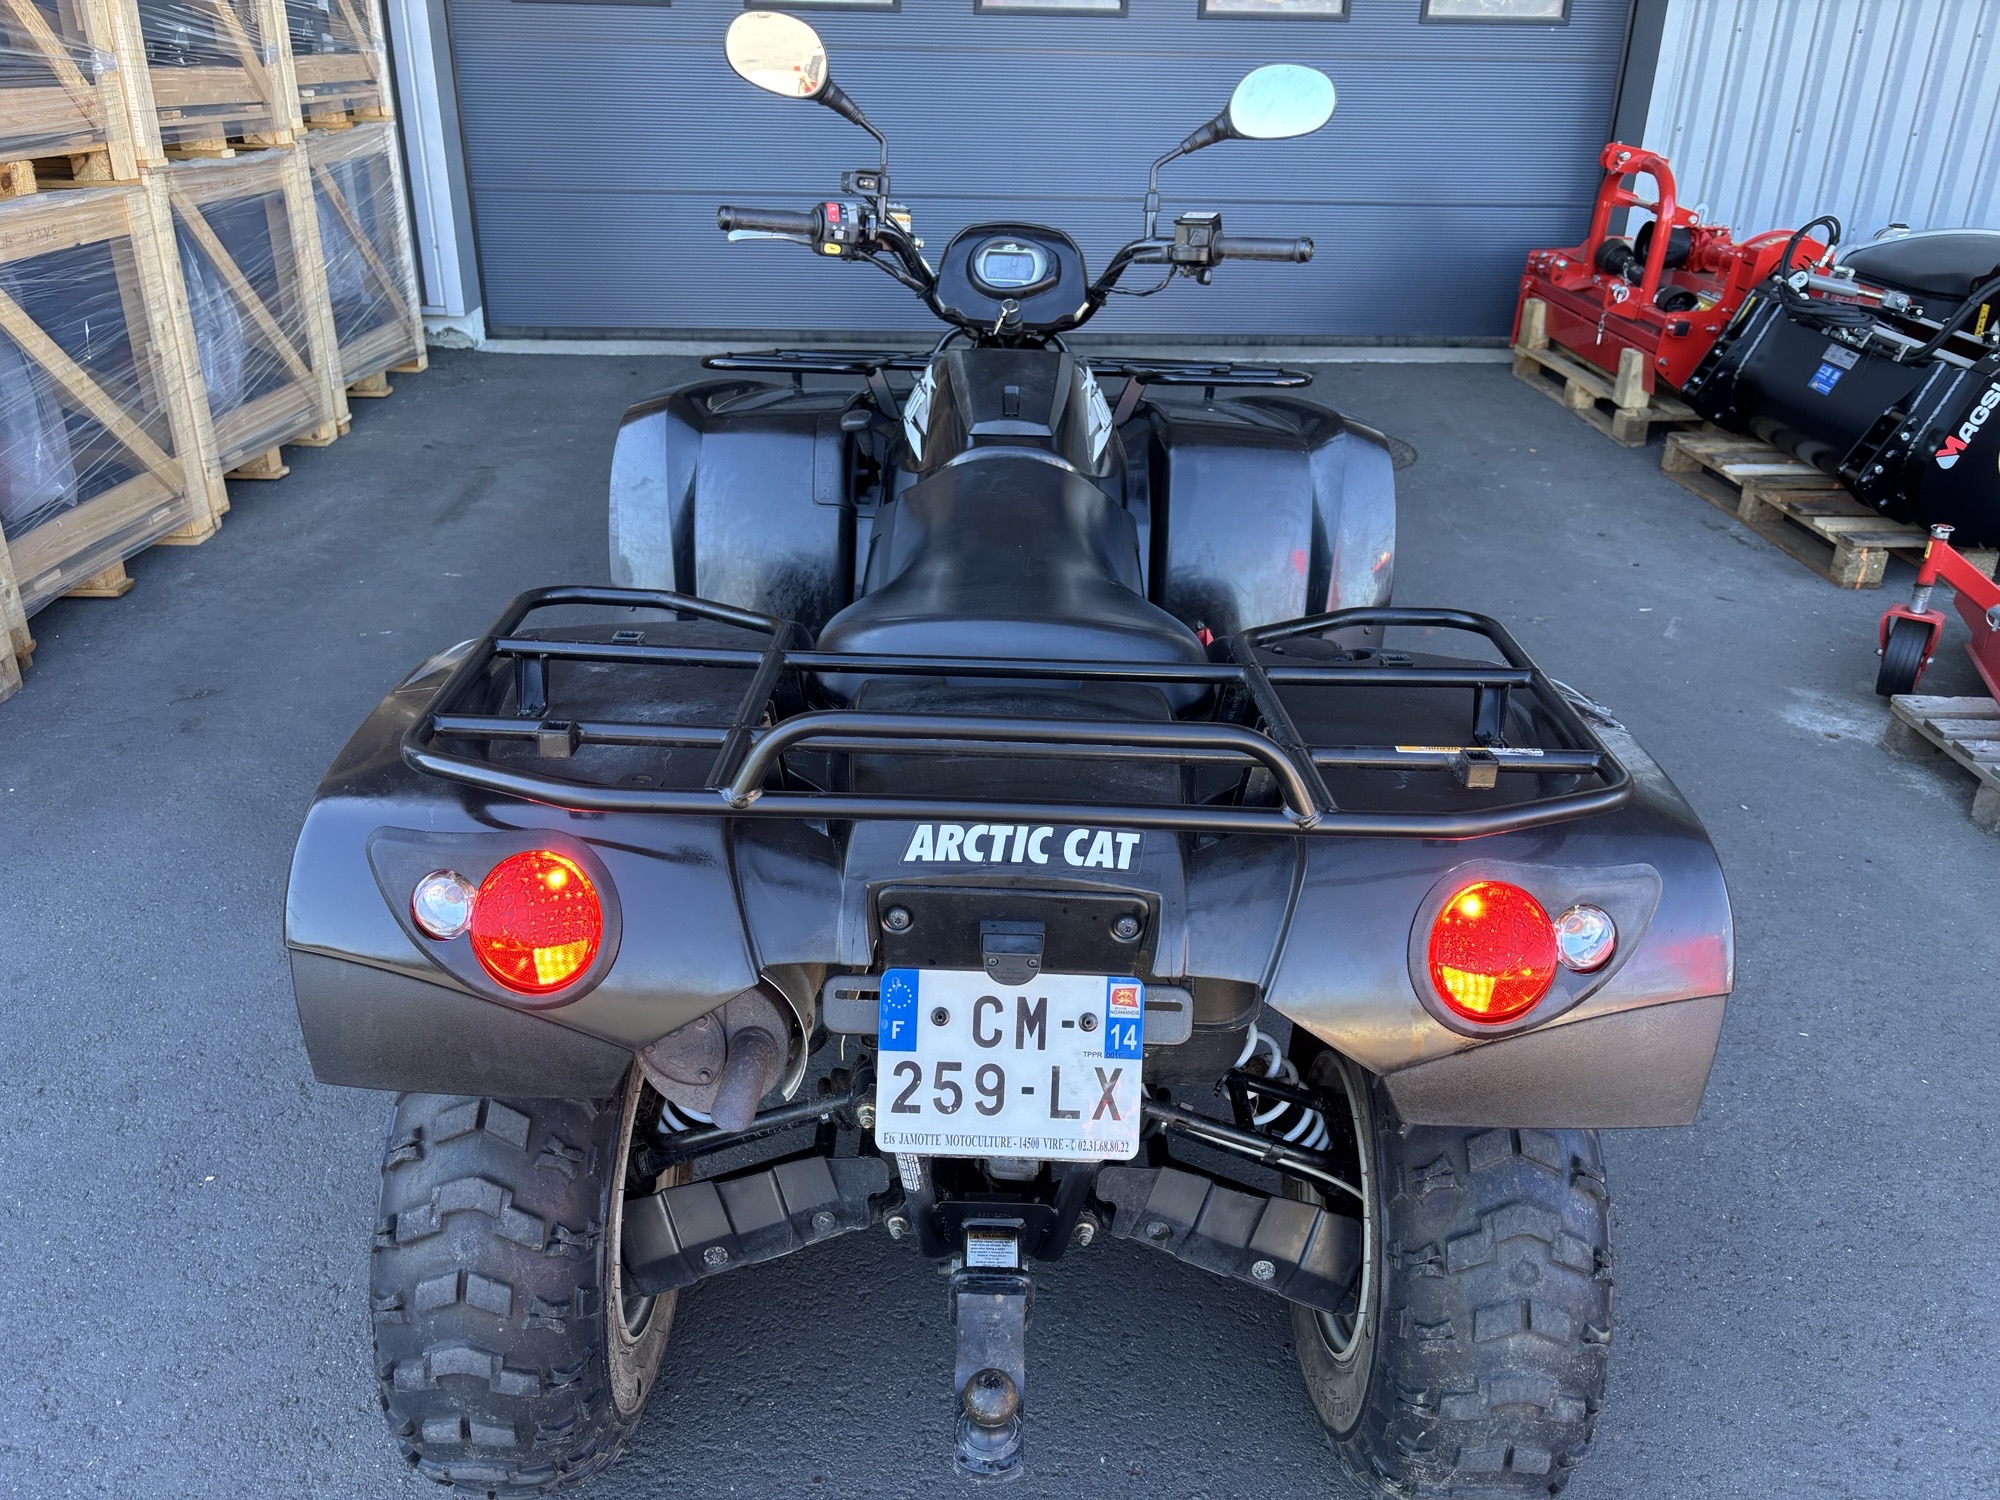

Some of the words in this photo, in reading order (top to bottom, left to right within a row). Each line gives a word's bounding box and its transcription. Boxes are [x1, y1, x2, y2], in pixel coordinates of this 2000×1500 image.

[903, 824, 1054, 864] ARCTIC
[1063, 828, 1141, 870] CAT
[891, 1020, 905, 1039] F
[1110, 1023, 1138, 1051] 14
[883, 1132, 896, 1144] Ets
[899, 1133, 941, 1146] JAMOTTE
[945, 1134, 1012, 1148] MOTOCULTURE
[1019, 1137, 1039, 1149] 14500
[1043, 1138, 1064, 1150] VIRE
[1078, 1140, 1129, 1153] 02.31.68.80.22
